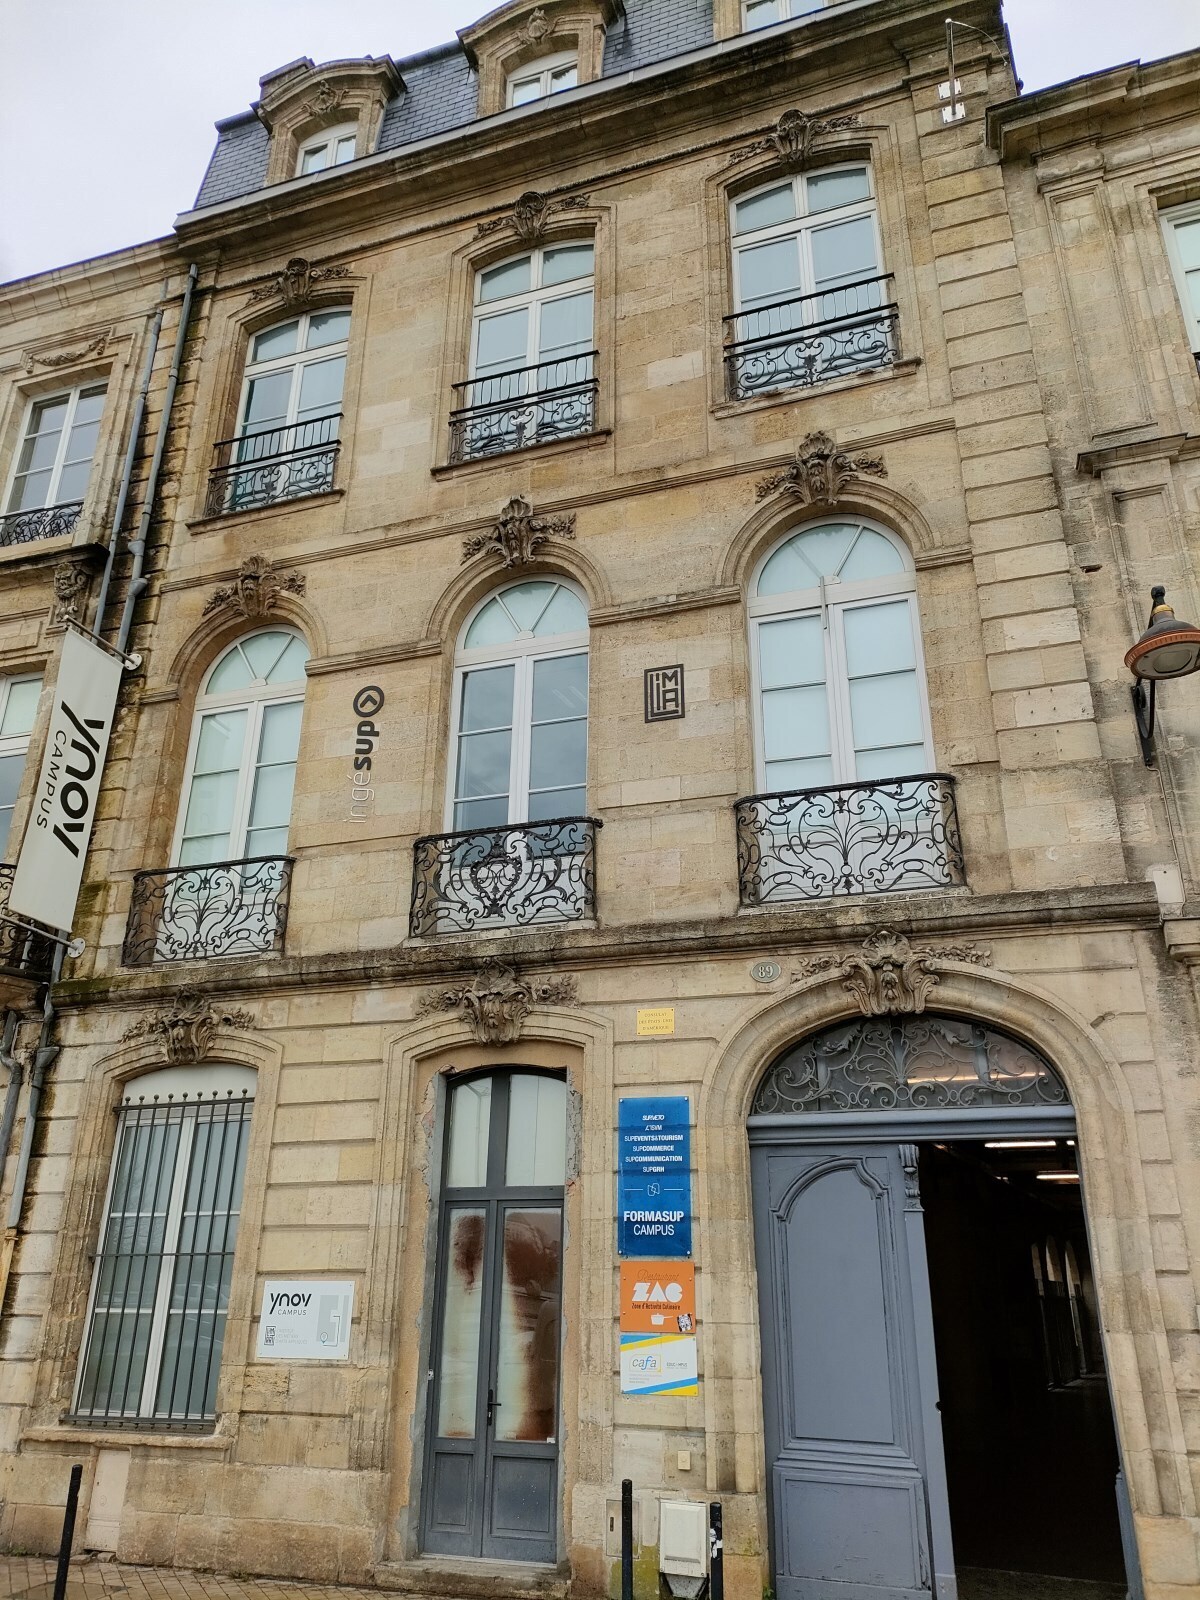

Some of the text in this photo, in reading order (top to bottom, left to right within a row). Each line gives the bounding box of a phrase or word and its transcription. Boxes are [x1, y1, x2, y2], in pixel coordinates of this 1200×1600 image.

[36, 729, 68, 830] CAMPUS
[52, 700, 107, 858] ynov
[342, 720, 381, 824] ingésup
[758, 965, 774, 978] 89
[625, 1155, 683, 1163] SUPCOMMUNICATION
[623, 1210, 685, 1222] FORMASUP
[633, 1224, 675, 1236] CAMPUS
[631, 1281, 683, 1303] ZAC
[269, 1292, 313, 1315] ynov
[631, 1302, 642, 1310] Zone
[632, 1355, 657, 1371] cafa
